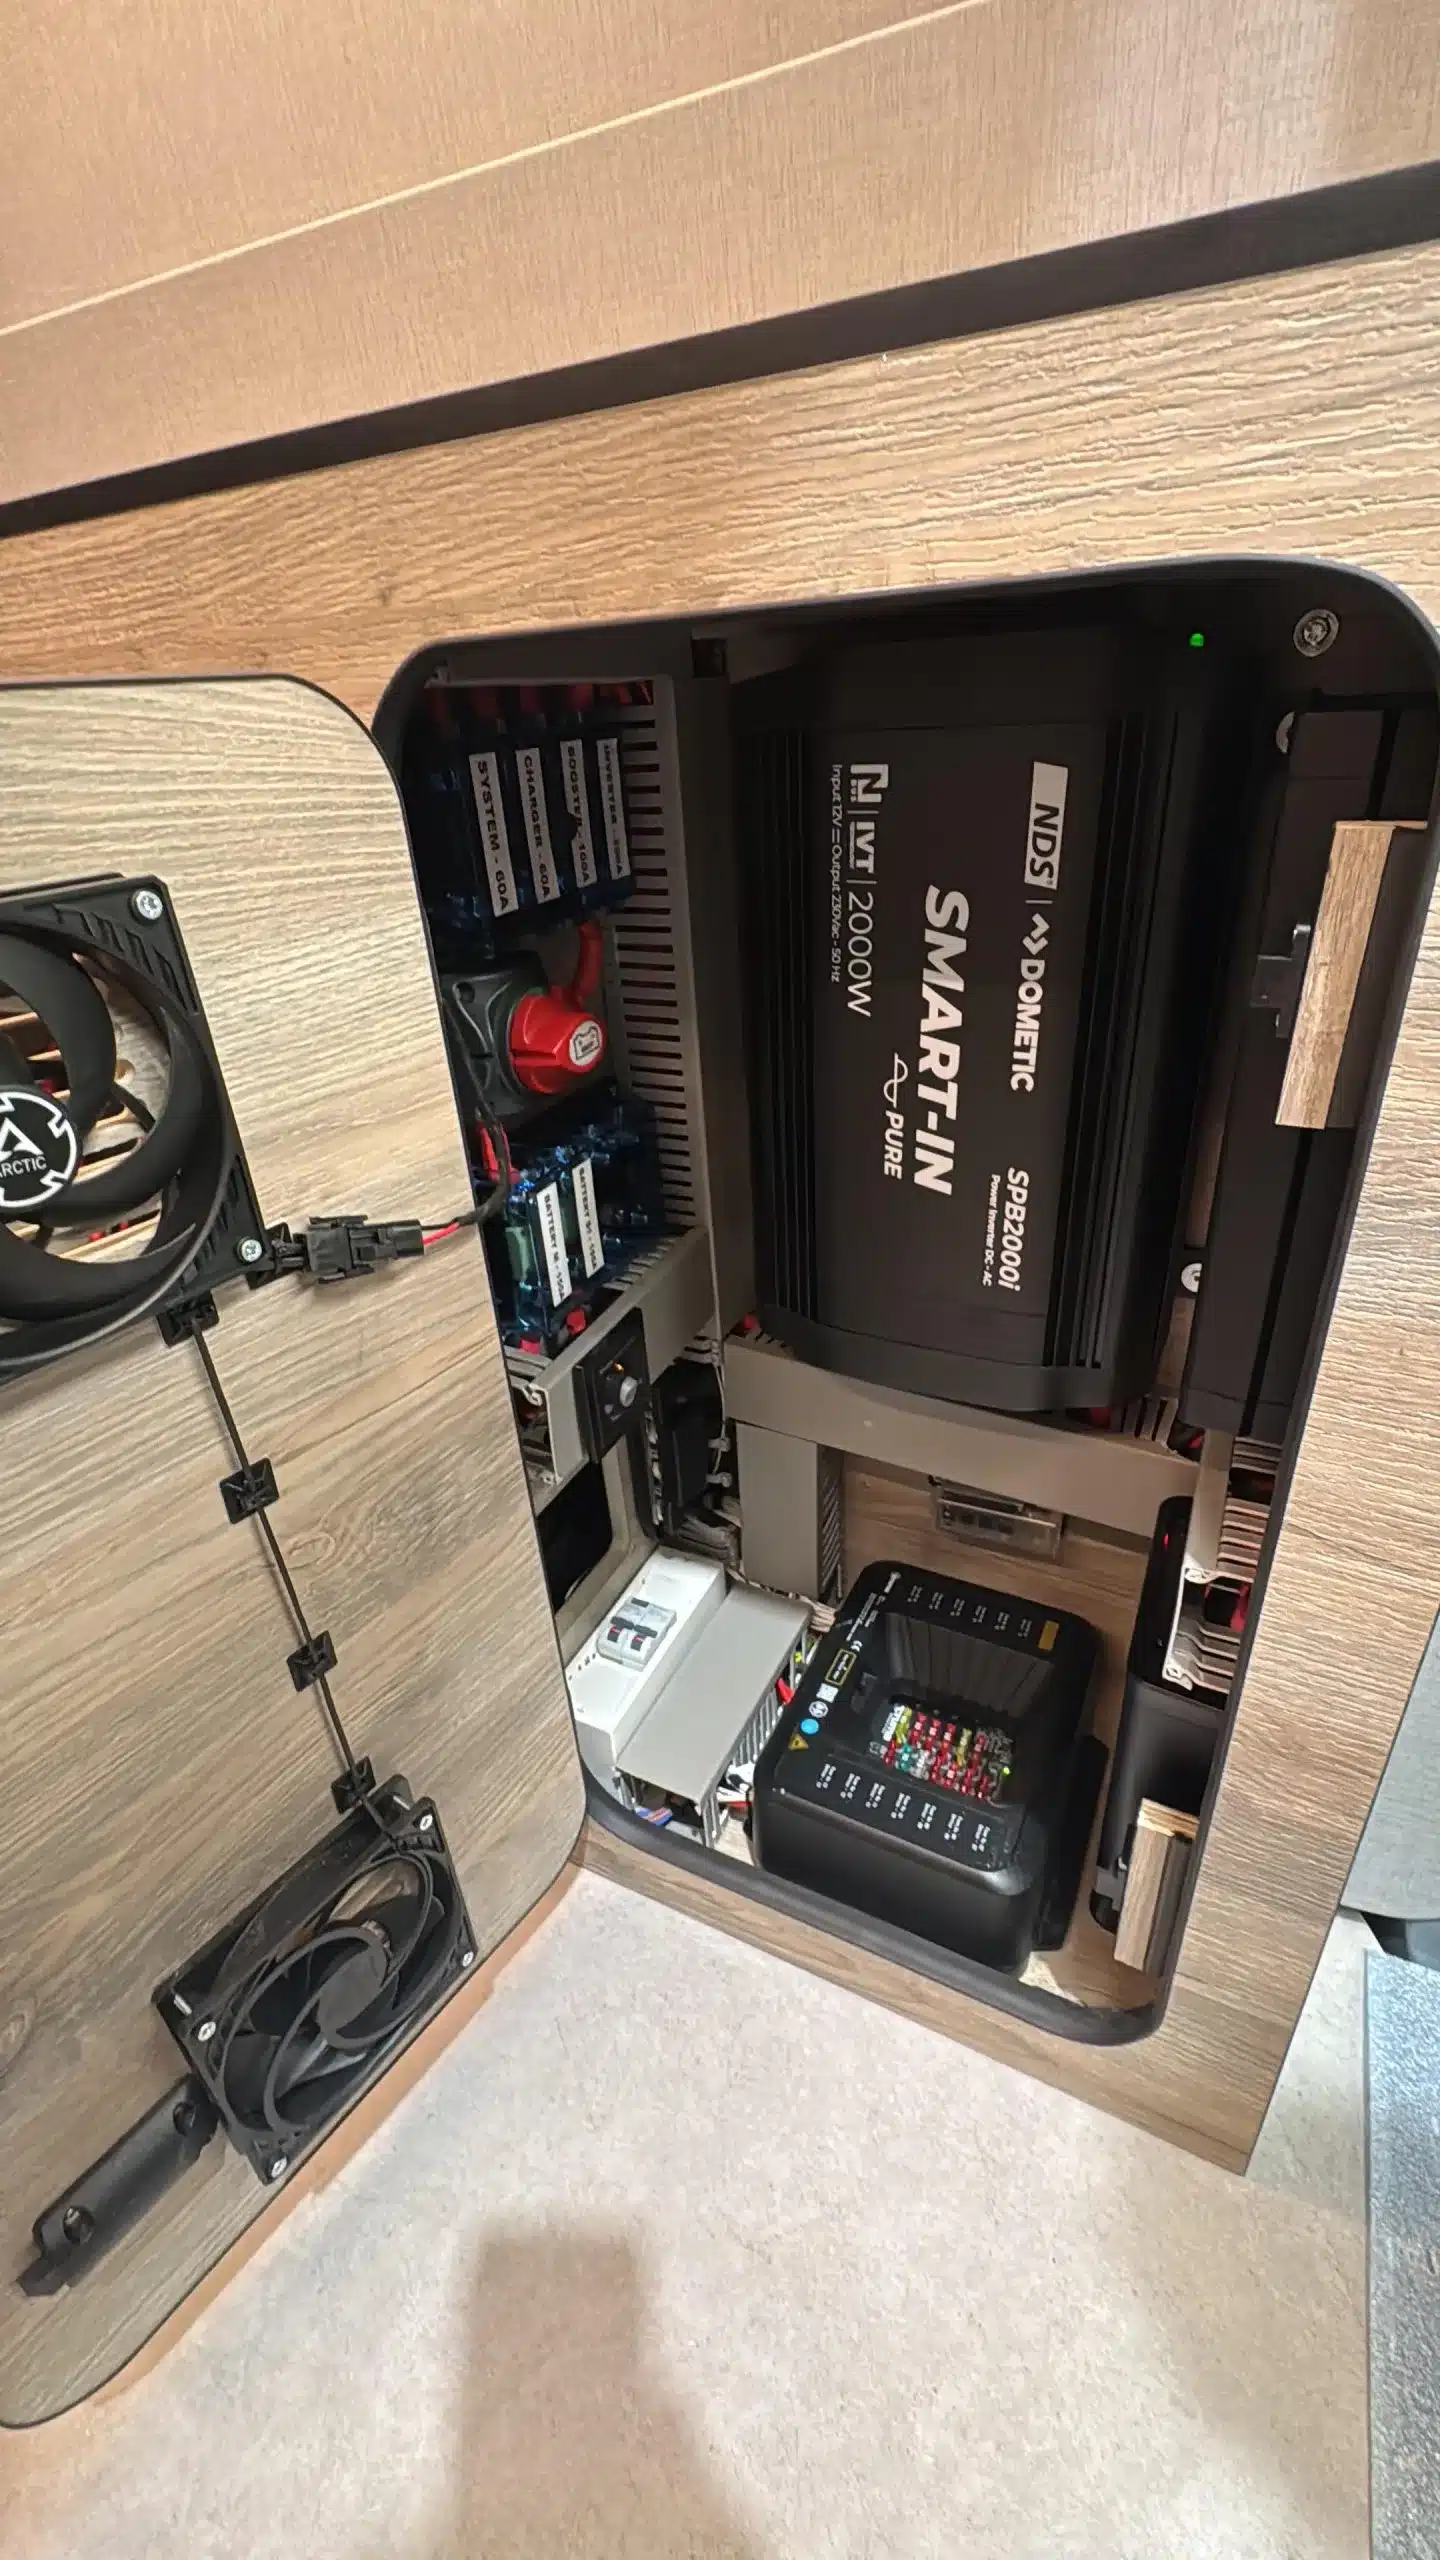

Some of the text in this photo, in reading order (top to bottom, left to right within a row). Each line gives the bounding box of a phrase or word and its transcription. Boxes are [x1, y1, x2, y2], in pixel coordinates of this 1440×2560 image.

[477, 760, 500, 850] SYSTEM
[524, 755, 542, 848] CHARGER
[567, 745, 583, 827] BOOSTER
[830, 764, 843, 803] Input
[829, 844, 843, 892] Output
[855, 821, 875, 874] IVT
[1030, 802, 1059, 879] NDS
[847, 891, 874, 1017] 2000W
[914, 884, 970, 1195] SMART-IN
[1010, 958, 1045, 1093] DOMETIC
[884, 1110, 904, 1180] PURE
[543, 1193, 558, 1249] BATTERY
[579, 1167, 590, 1218] BATTERY
[989, 1174, 1001, 1208] Power
[986, 1209, 998, 1248] Inverter
[998, 1167, 1029, 1291] SPB2000i
